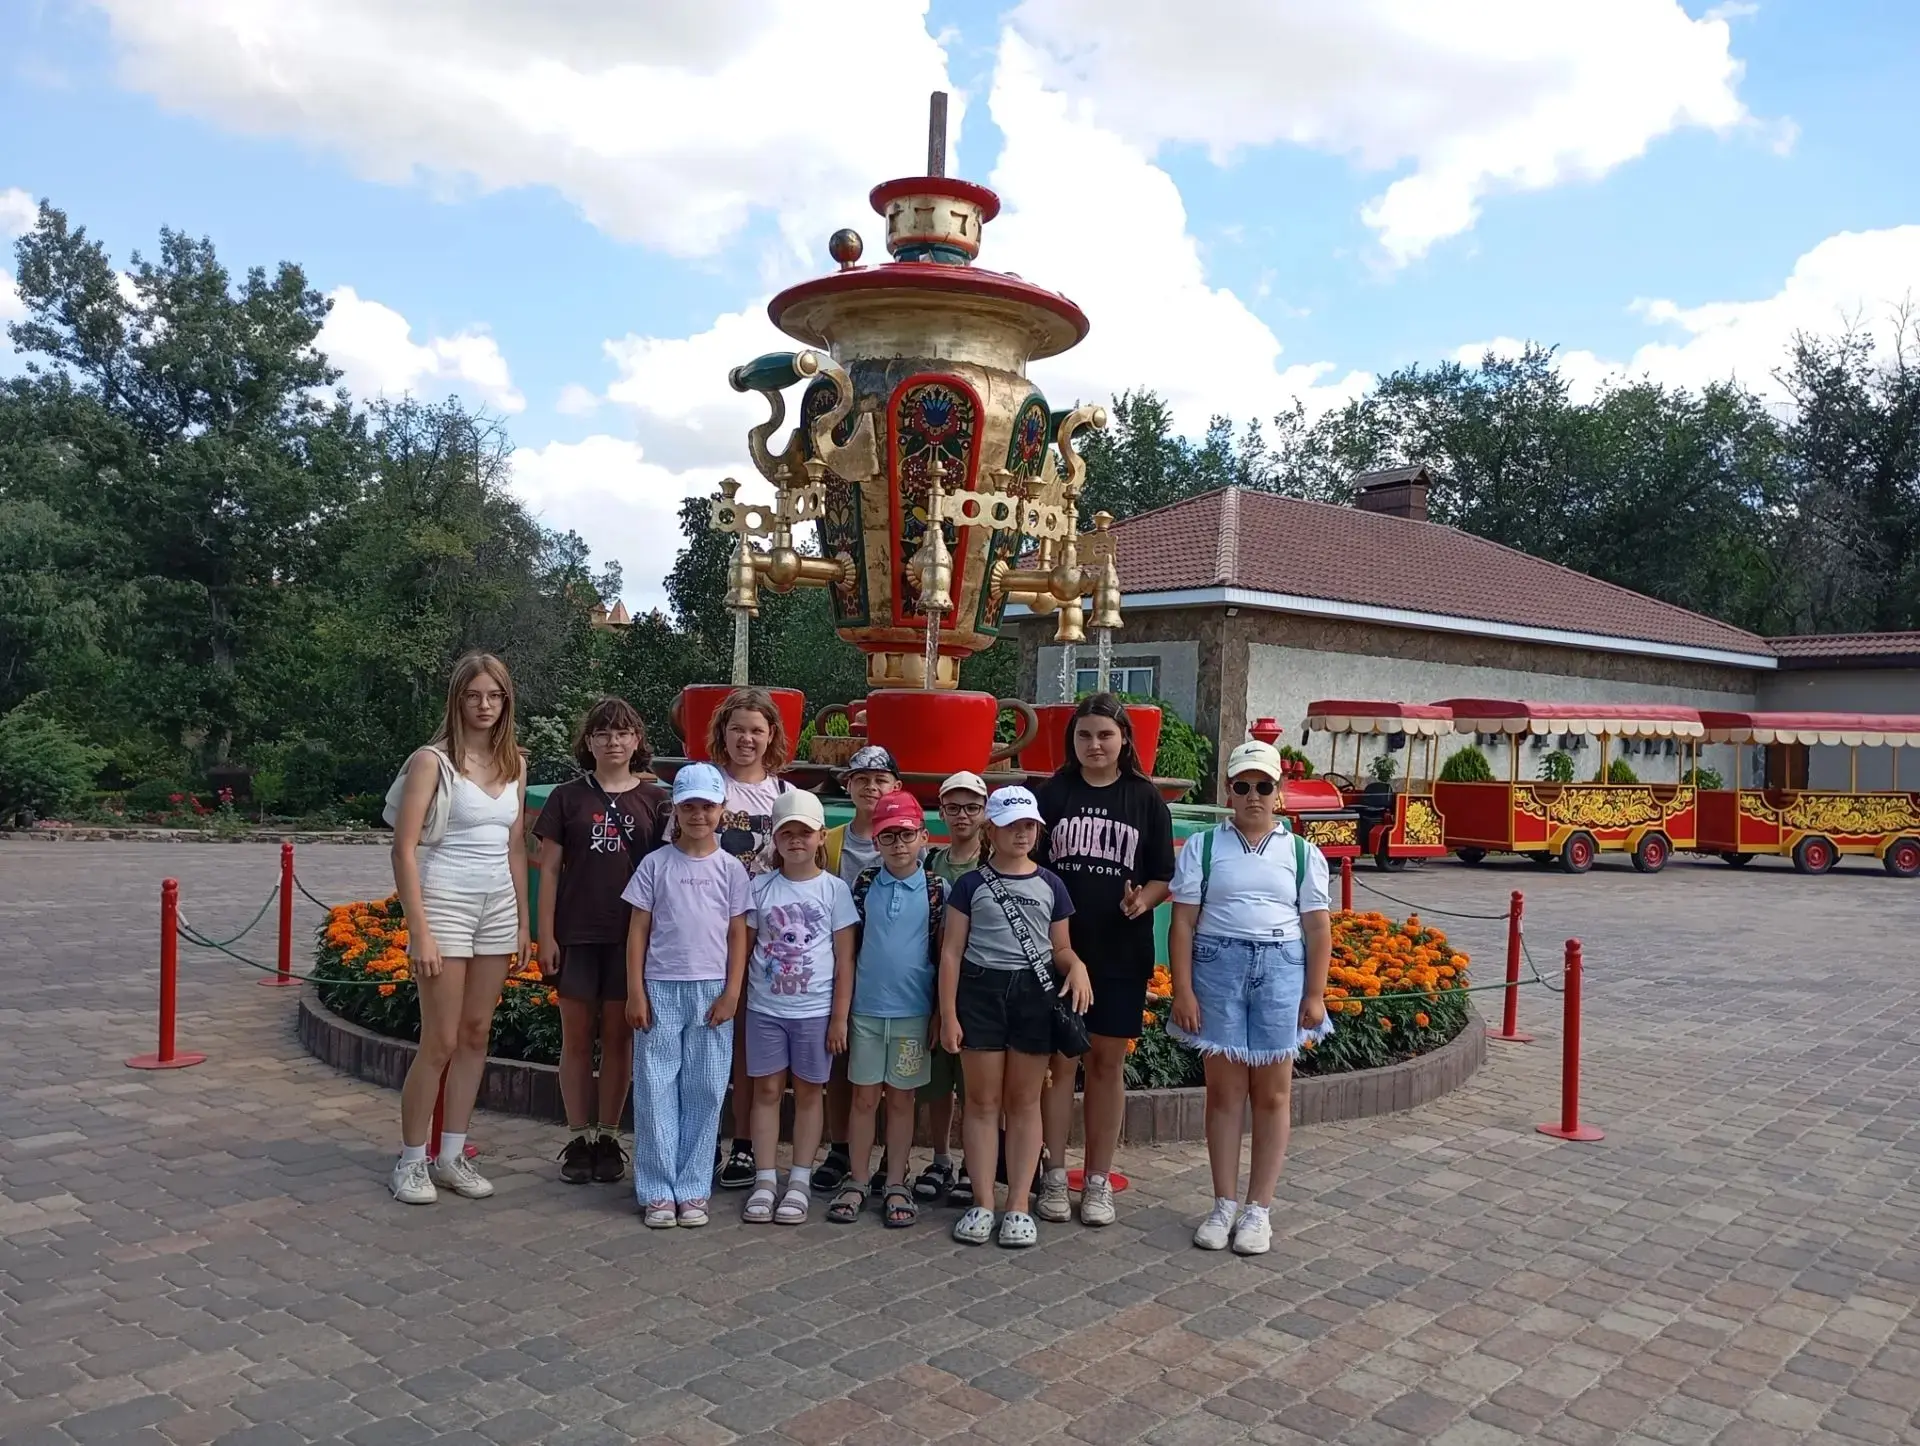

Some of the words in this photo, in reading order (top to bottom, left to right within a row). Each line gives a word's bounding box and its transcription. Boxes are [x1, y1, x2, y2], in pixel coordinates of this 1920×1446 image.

[1003, 797, 1032, 807] ecco
[1081, 806, 1108, 816] 1898
[1057, 862, 1081, 872] NEW
[1088, 865, 1122, 877] YORK
[988, 879, 1008, 899] NICE
[1001, 898, 1019, 919] NICE
[1011, 917, 1029, 939] NICE
[1021, 938, 1040, 961] NICE
[1032, 960, 1050, 983] NICE
